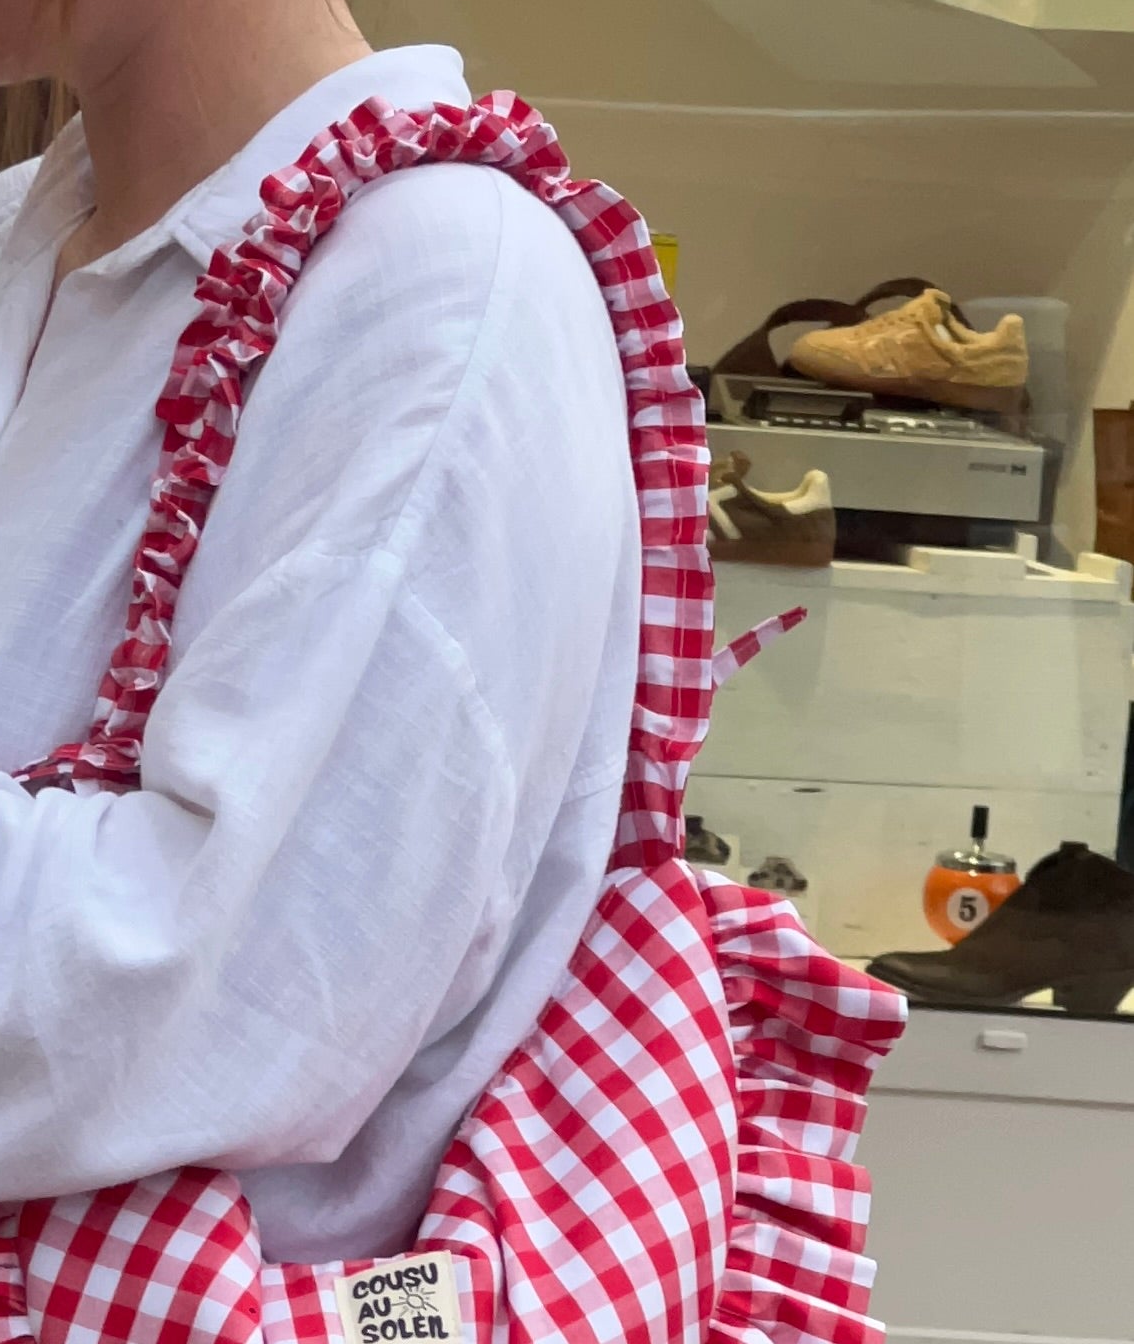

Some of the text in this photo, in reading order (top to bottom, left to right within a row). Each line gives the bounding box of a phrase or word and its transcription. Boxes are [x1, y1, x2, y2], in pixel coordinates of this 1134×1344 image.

[958, 895, 978, 923] 5
[352, 1261, 439, 1300] COUSU
[357, 1296, 392, 1324] AU
[360, 1315, 450, 1344] SOLEIL
